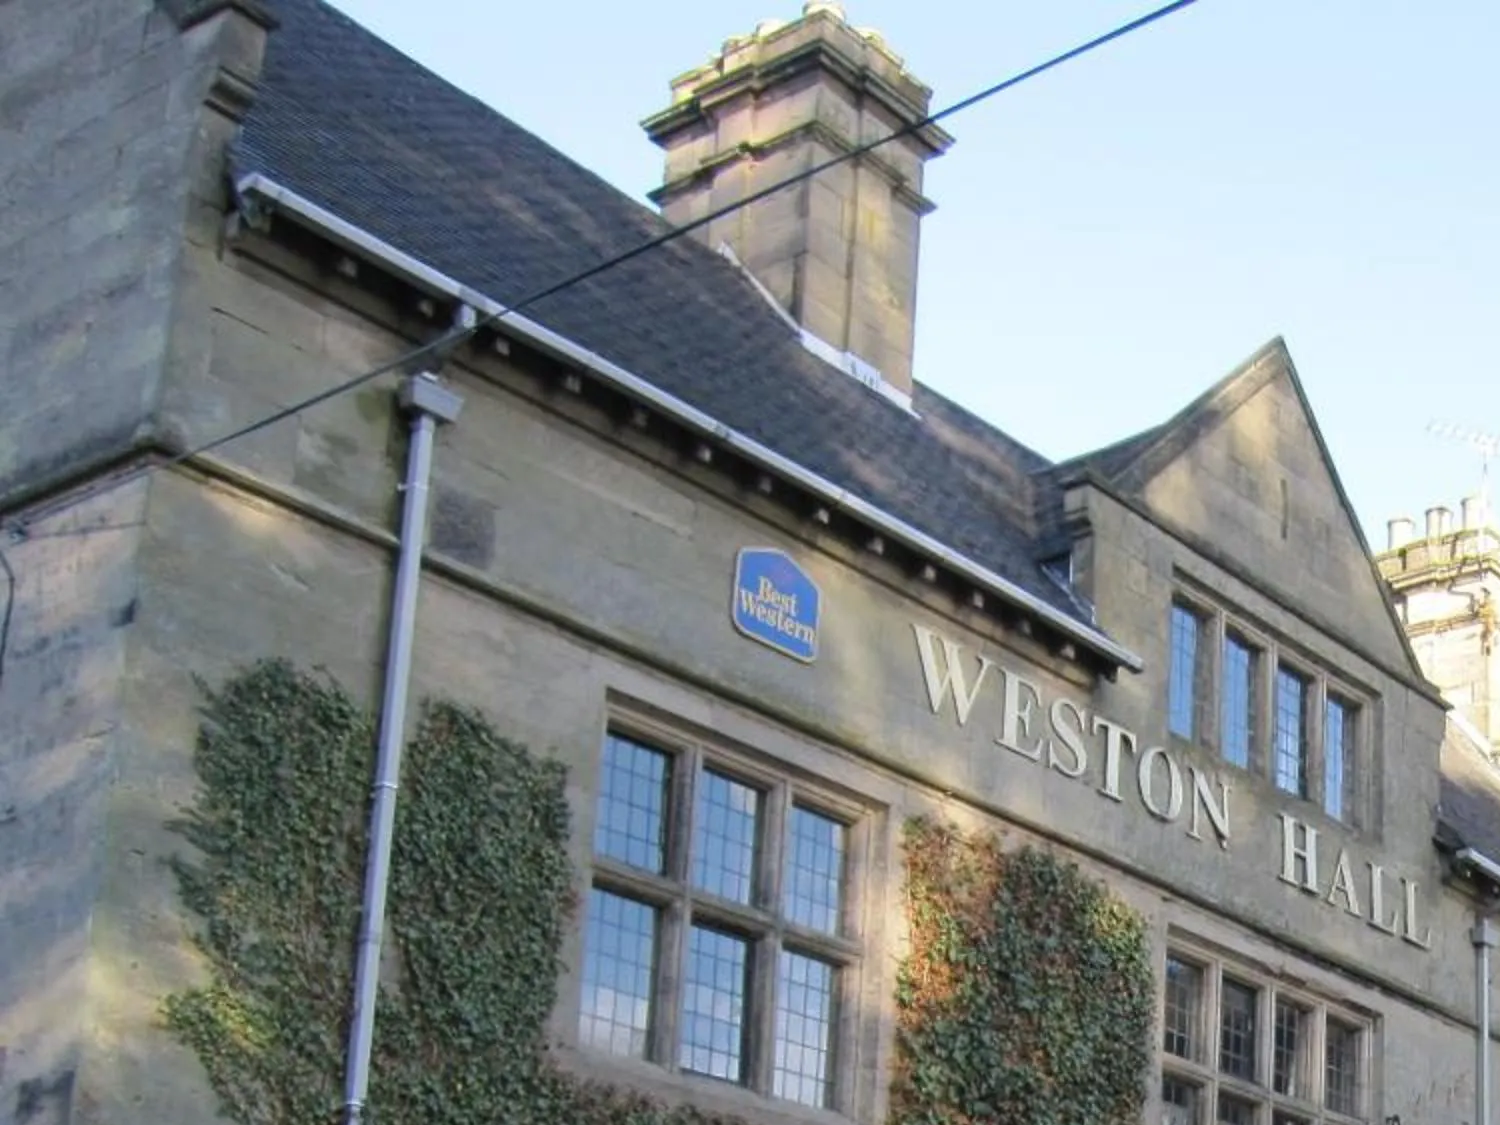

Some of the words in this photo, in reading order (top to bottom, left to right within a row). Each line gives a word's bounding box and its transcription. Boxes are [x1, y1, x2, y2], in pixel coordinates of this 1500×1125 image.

[740, 588, 815, 645] Western
[759, 576, 797, 617] Best
[911, 624, 1232, 850] WESTON
[1278, 813, 1432, 949] HALL
